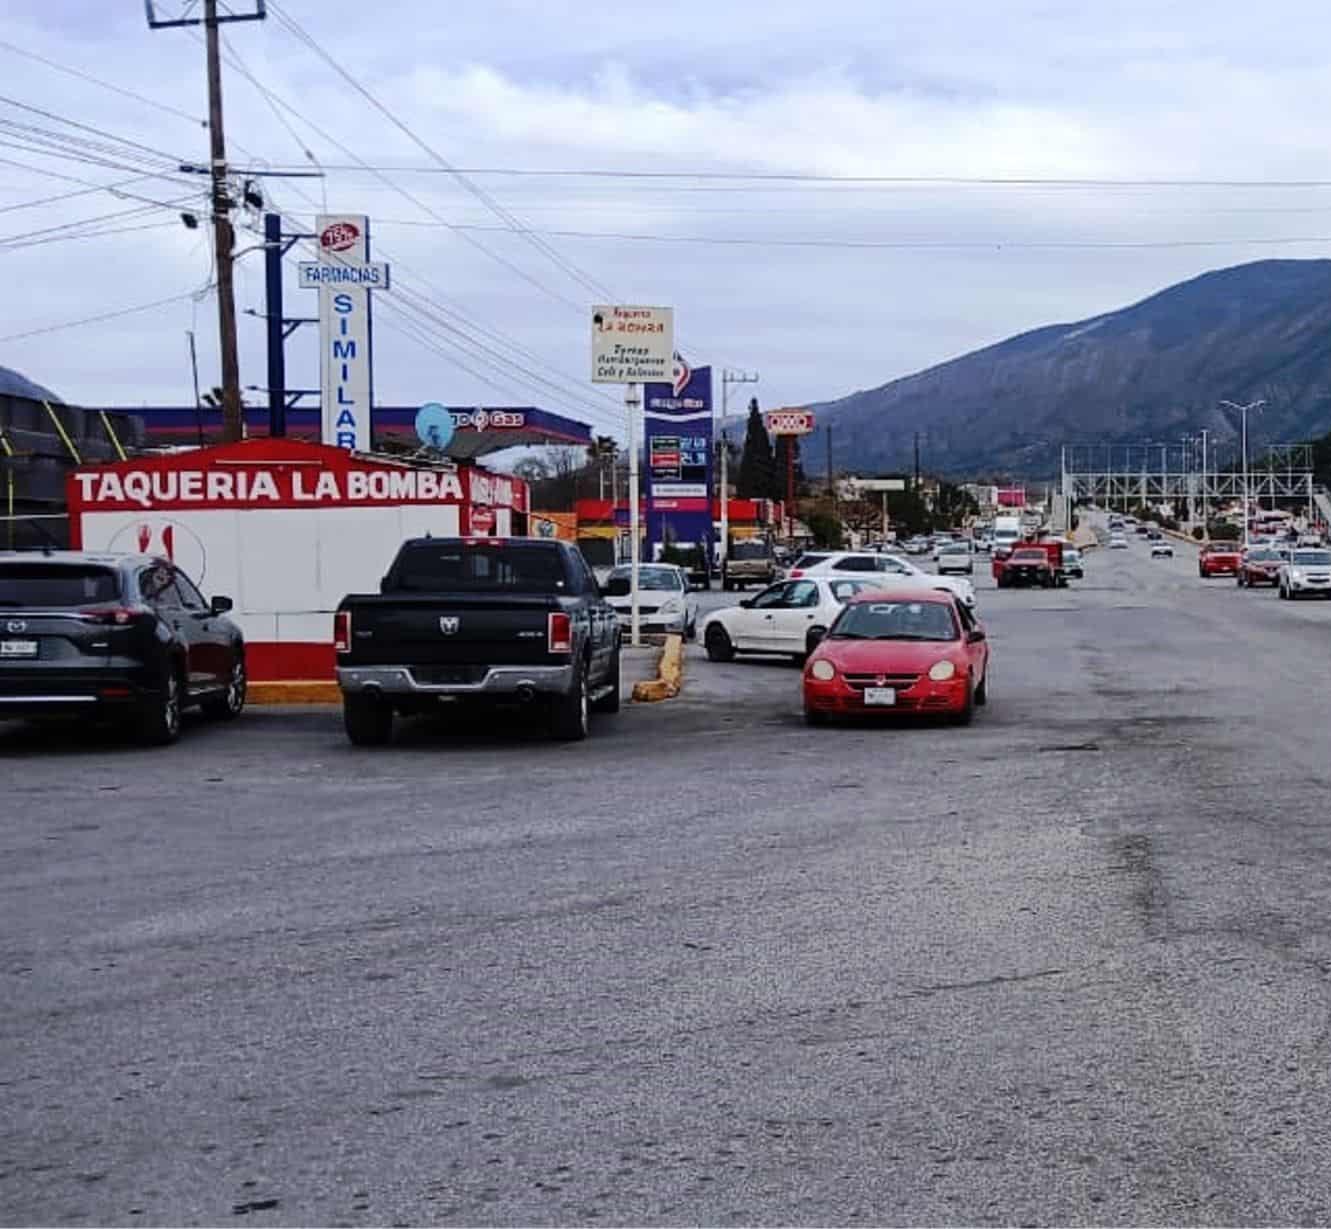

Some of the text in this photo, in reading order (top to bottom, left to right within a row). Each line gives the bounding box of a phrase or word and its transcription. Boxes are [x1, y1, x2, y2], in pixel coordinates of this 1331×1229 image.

[305, 267, 379, 283] FARMACIAS
[489, 410, 524, 427] Gas
[769, 414, 809, 430] OXXO
[75, 471, 280, 507] TAQUERIA
[293, 471, 341, 500] LA
[347, 471, 464, 500] BOMBA
